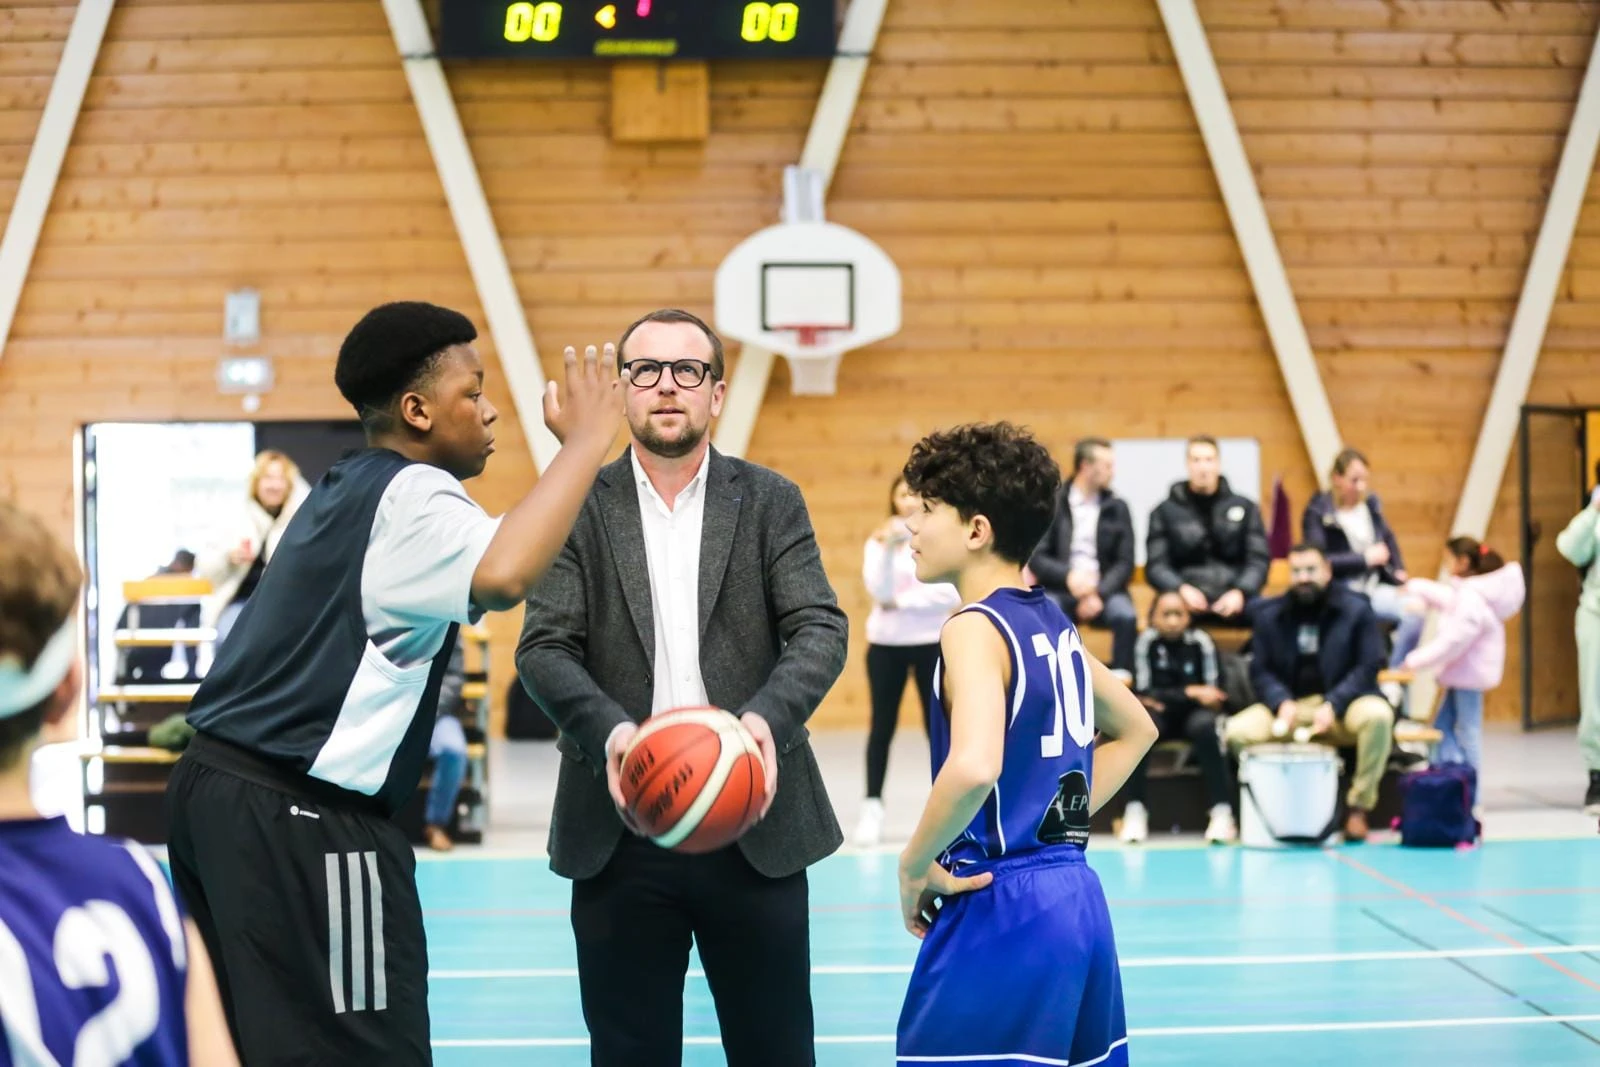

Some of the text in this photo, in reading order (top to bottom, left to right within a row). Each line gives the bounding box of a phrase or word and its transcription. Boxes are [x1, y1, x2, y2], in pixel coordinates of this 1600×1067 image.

[504, 2, 562, 42] 00
[741, 2, 799, 42] 00
[1031, 625, 1095, 758] 10
